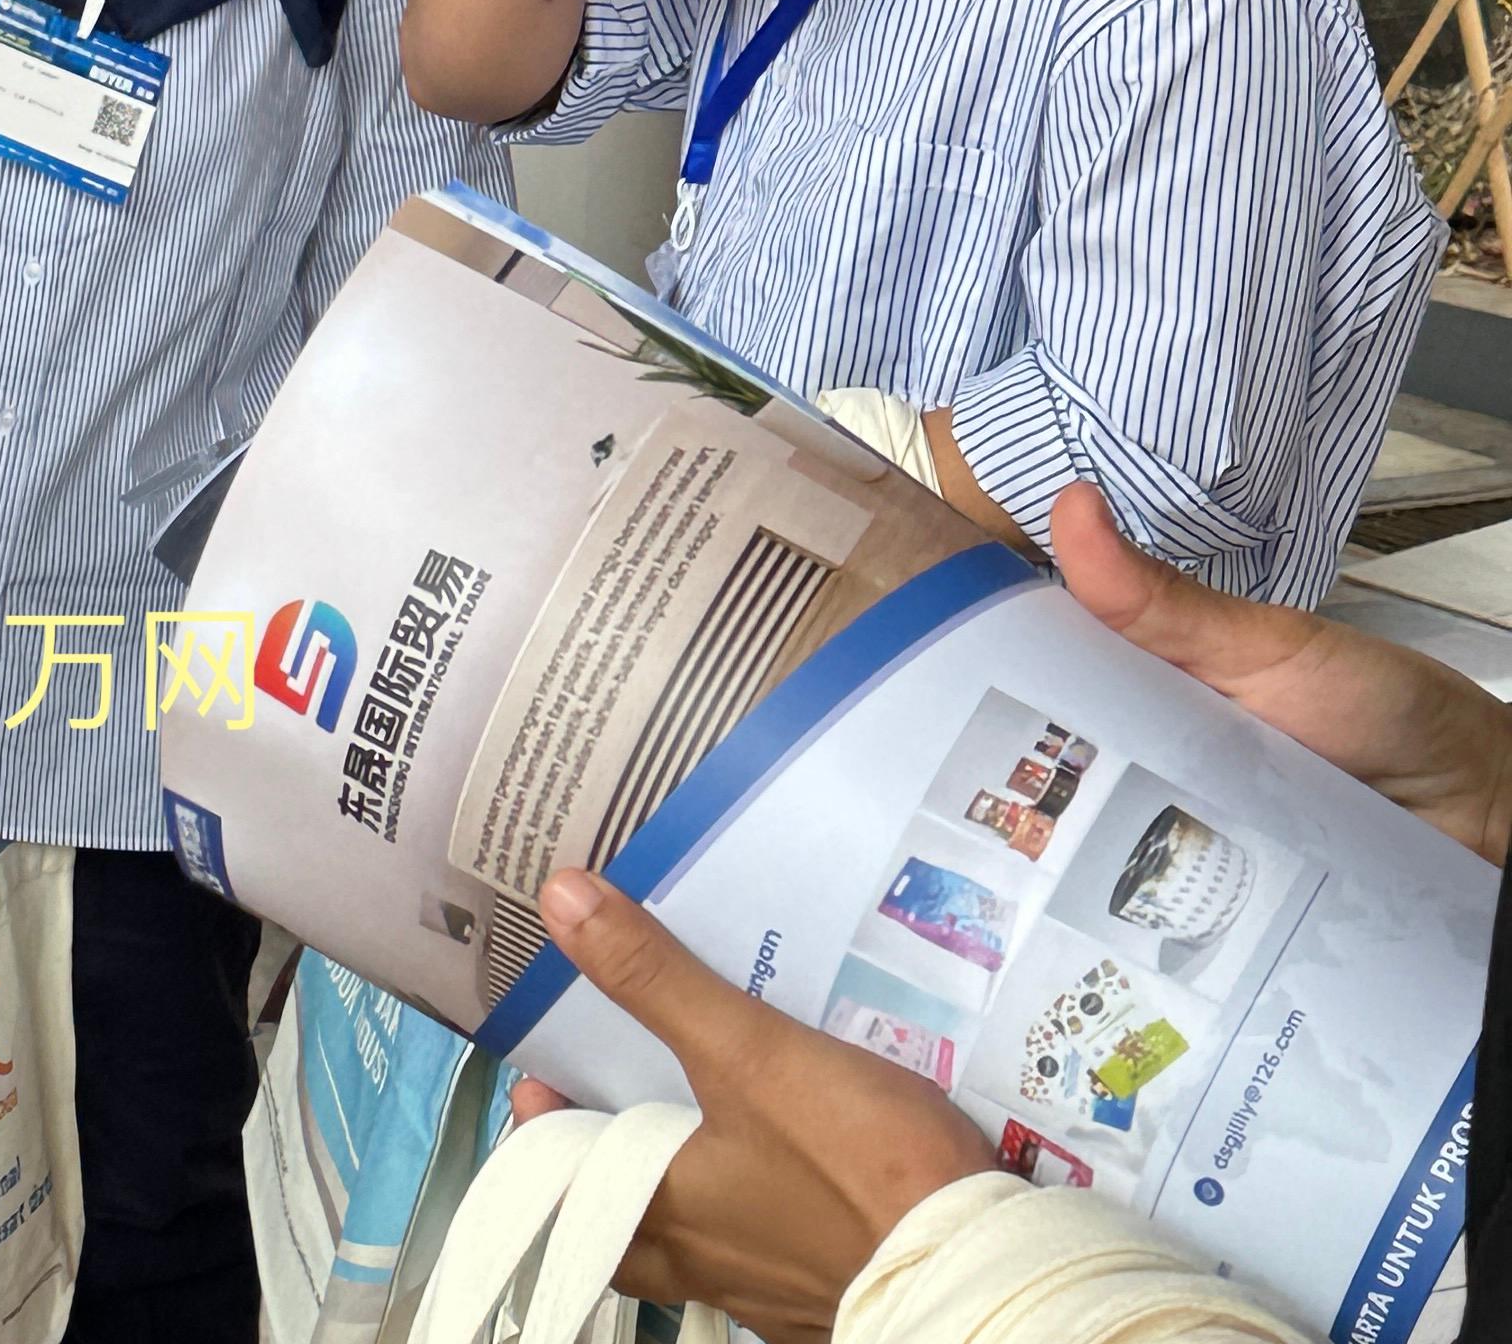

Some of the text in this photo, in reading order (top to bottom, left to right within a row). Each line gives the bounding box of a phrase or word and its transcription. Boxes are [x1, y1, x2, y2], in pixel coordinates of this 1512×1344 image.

[459, 568, 494, 628] TRADE
[337, 549, 475, 835] 东晟国际贸易
[1376, 1183, 1447, 1290] UNTUK
